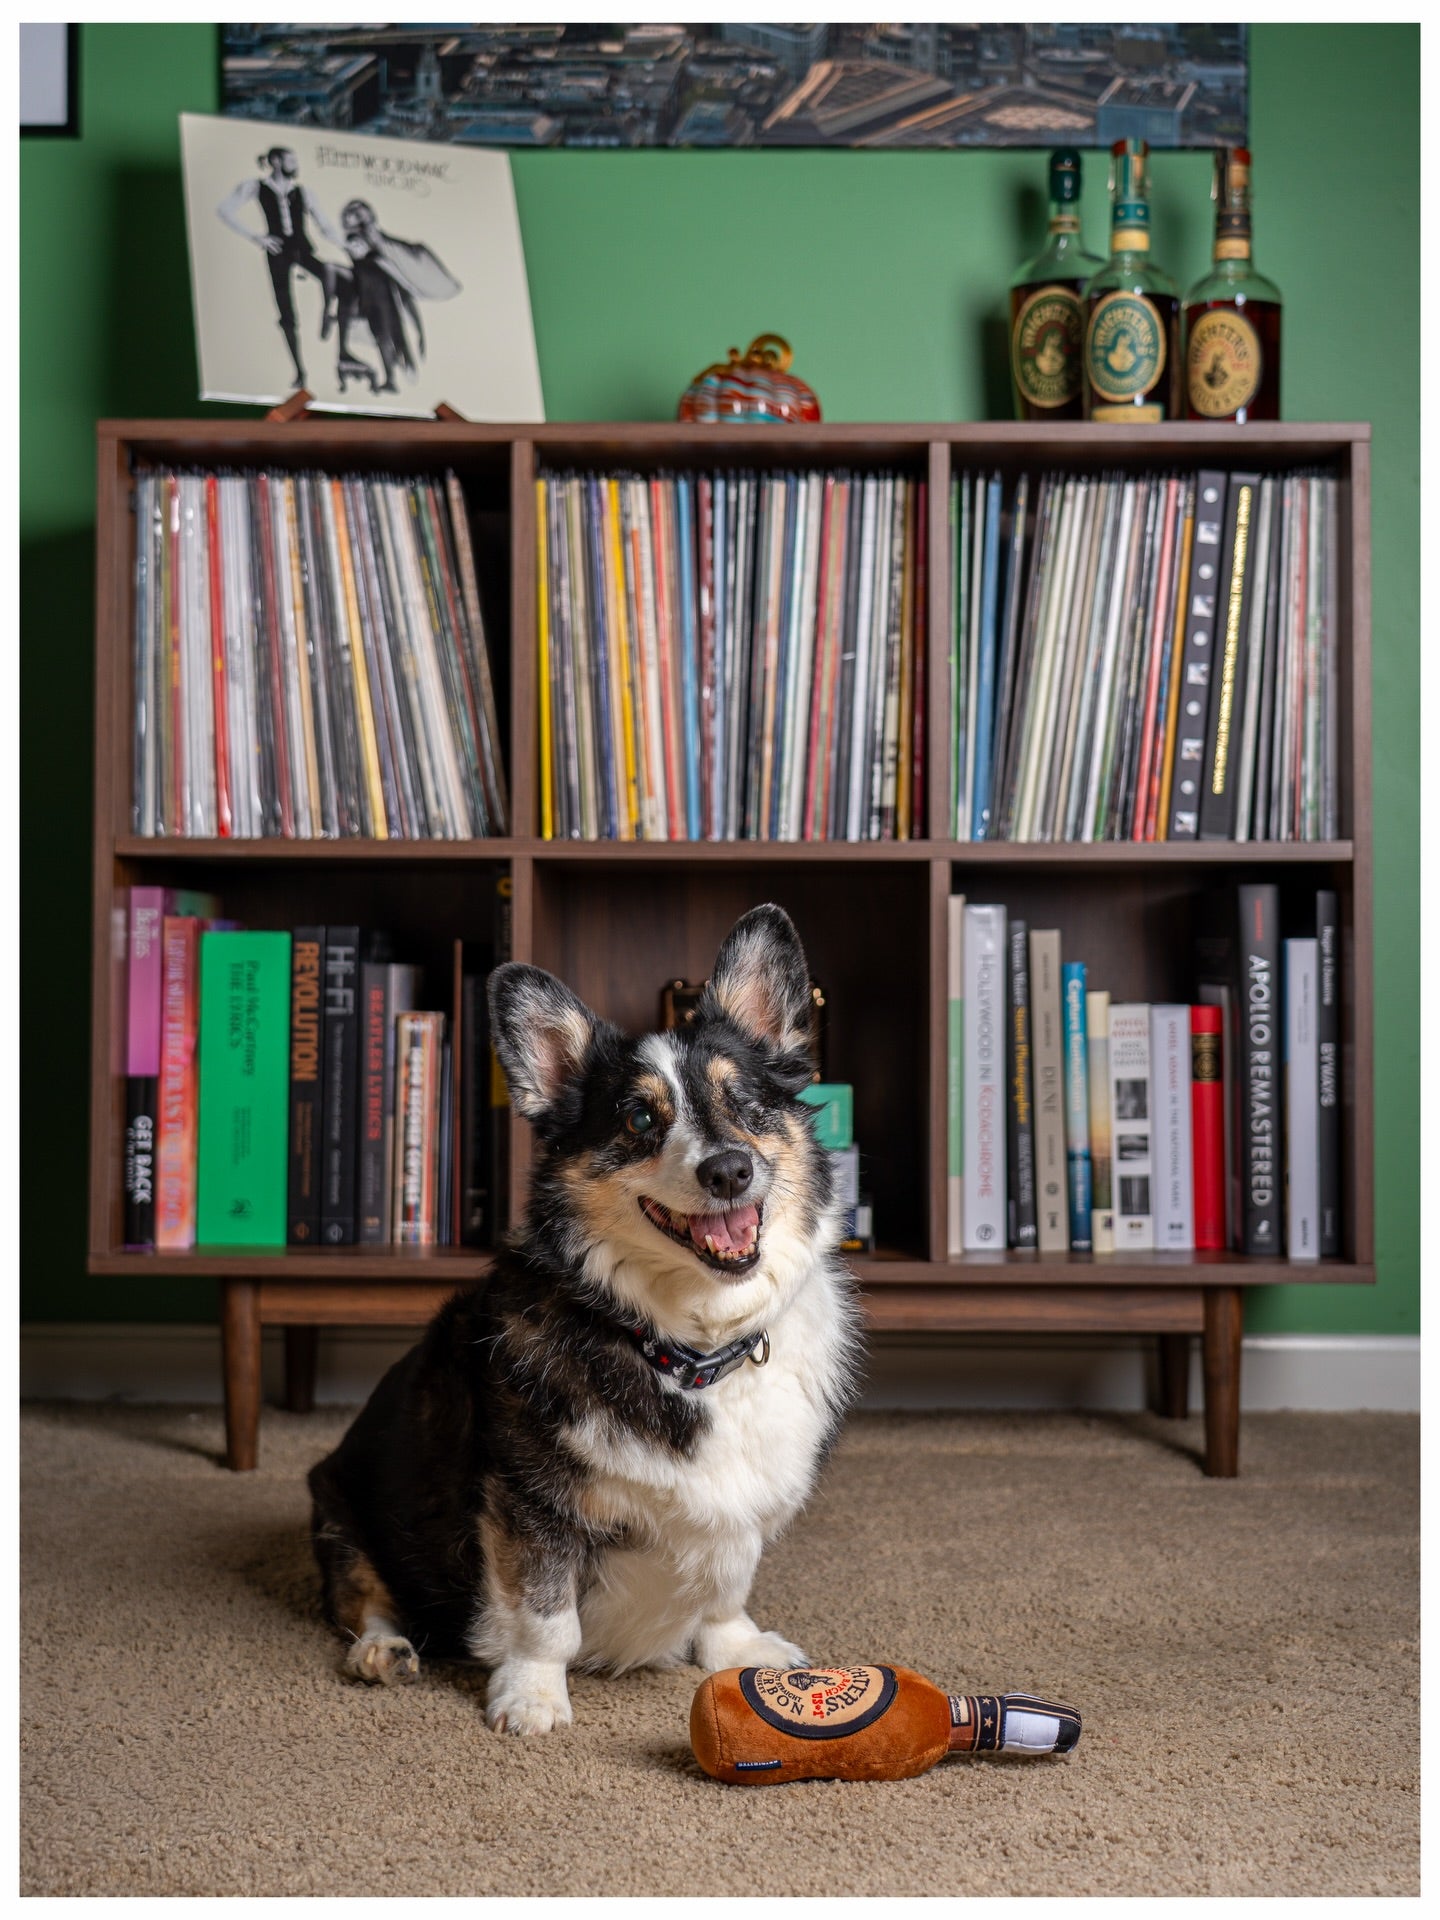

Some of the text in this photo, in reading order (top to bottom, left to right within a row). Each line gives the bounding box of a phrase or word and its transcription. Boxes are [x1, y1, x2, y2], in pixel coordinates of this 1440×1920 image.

[229, 962, 244, 991] THE
[326, 945, 355, 1016] Hi-Fi
[1067, 978, 1083, 1032] Capture
[242, 960, 261, 1076] Paul McCartney
[292, 941, 320, 1082] REVOLUTION
[367, 990, 384, 1071] BEATLES
[1014, 1006, 1026, 1036] Street
[976, 952, 995, 1199] HOLLYWOOD IN KODACHROME
[1013, 1036, 1030, 1125] Photographer
[1042, 1066, 1058, 1114] DUNE
[1248, 953, 1273, 1208] APOLLO REMASTERED
[1320, 1042, 1335, 1107] BYWAYS
[366, 1075, 383, 1140] LYRICS
[132, 1115, 154, 1205] GET BACK
[757, 1671, 767, 1695] WHISKEY
[775, 1681, 803, 1702] STRAIGHT
[826, 1678, 851, 1697] BATCH
